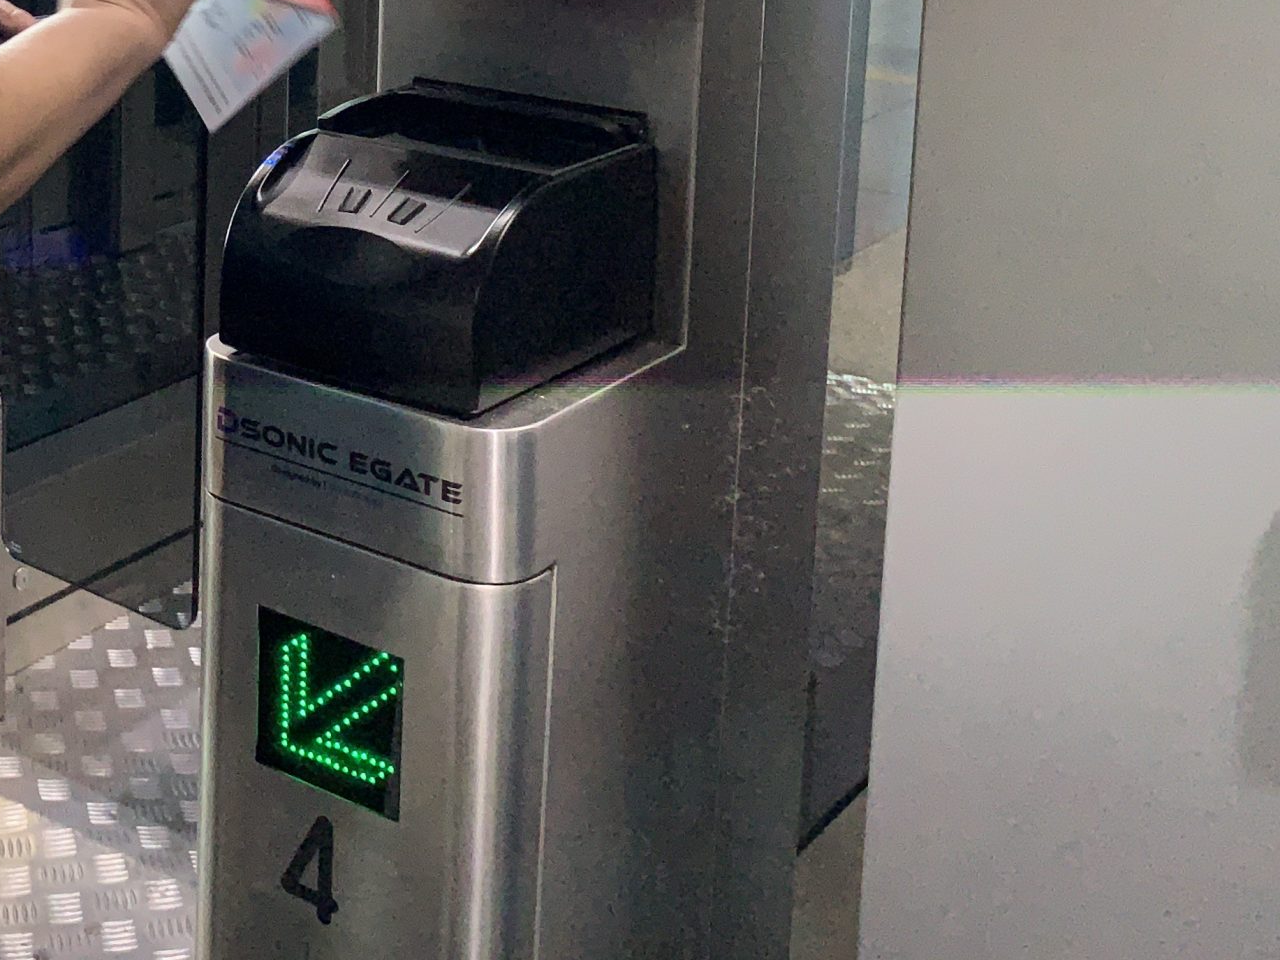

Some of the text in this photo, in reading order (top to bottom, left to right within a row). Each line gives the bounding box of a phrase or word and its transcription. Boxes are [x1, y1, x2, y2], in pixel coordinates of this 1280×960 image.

[216, 405, 339, 466] DSONIC
[348, 450, 464, 506] EGATE
[280, 815, 339, 925] 4
